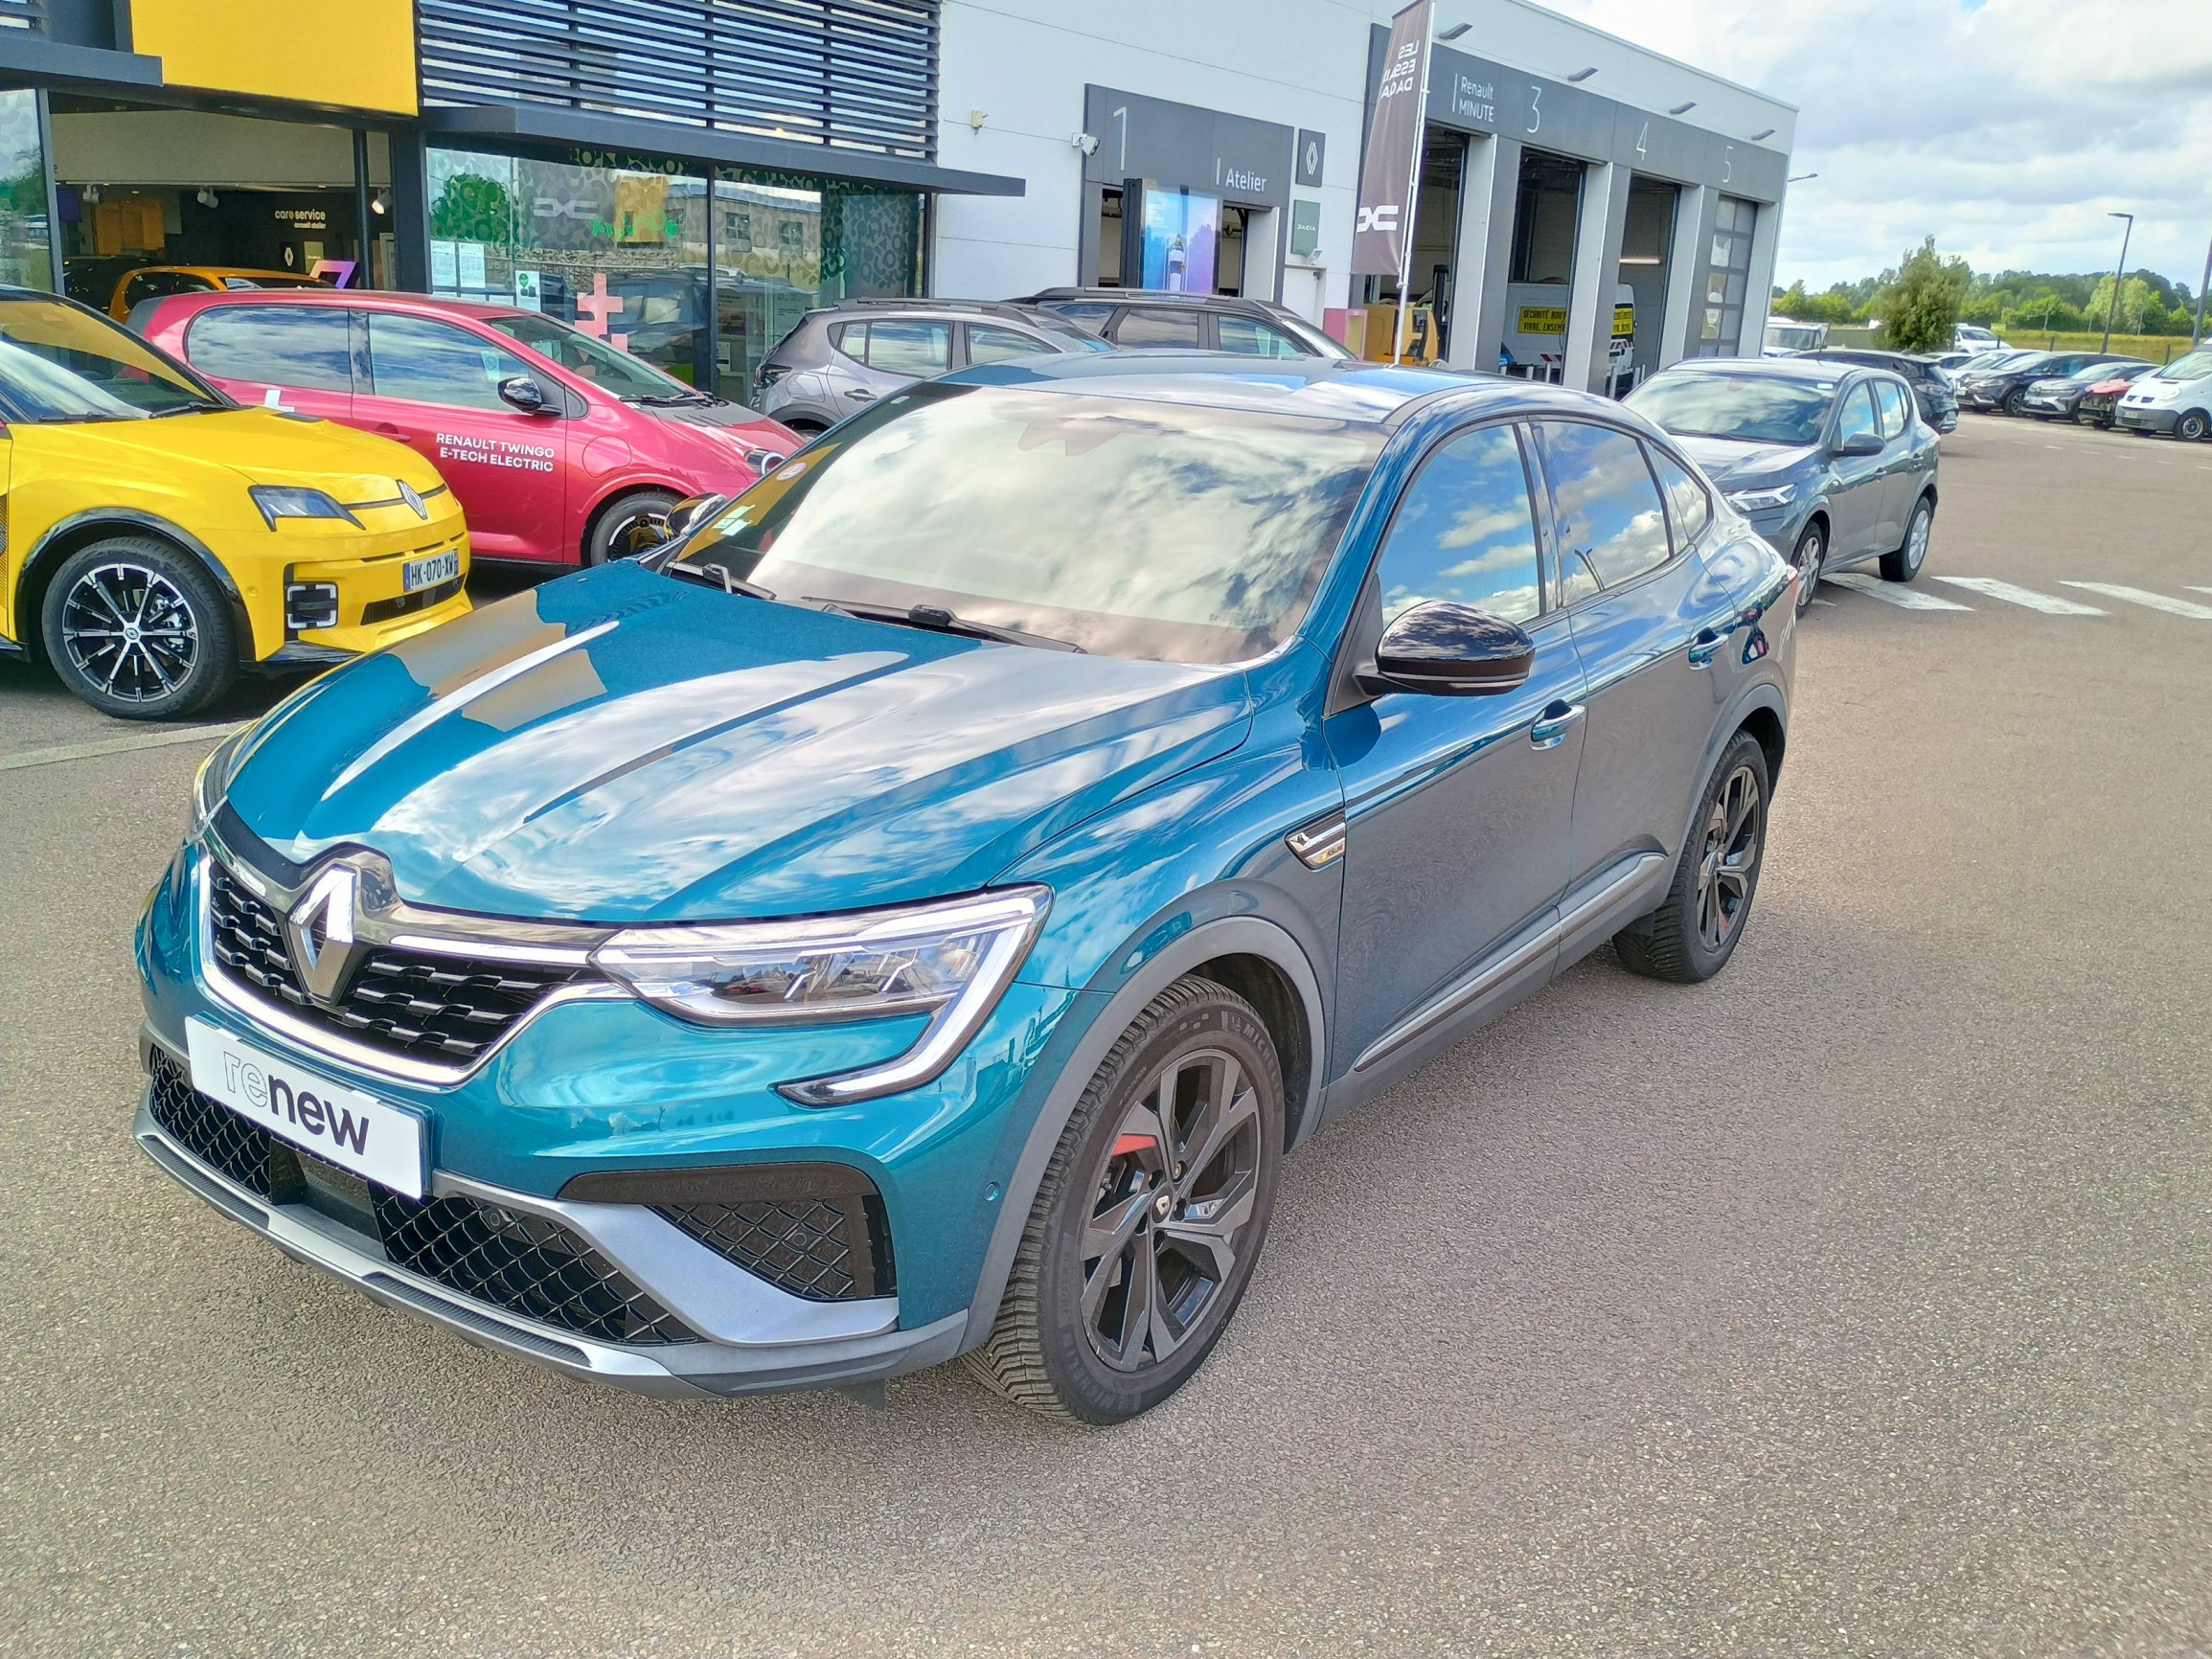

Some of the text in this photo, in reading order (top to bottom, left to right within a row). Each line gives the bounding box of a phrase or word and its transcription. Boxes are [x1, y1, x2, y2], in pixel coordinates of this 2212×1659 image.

[1461, 76, 1494, 101] Renault
[1458, 98, 1494, 123] MINUTE
[1526, 85, 1541, 133] 3
[1112, 106, 1128, 171] 1
[1635, 121, 1649, 162] 4
[1722, 145, 1734, 184] 5
[1225, 168, 1267, 193] Atelier
[294, 208, 326, 220] service
[1296, 223, 1317, 232] DACIA
[436, 433, 556, 459] RENAULT TWINGO
[439, 446, 554, 472] E-TECH ELECTRIC
[411, 554, 454, 586] HK-070-XW
[223, 1051, 370, 1156] renew
